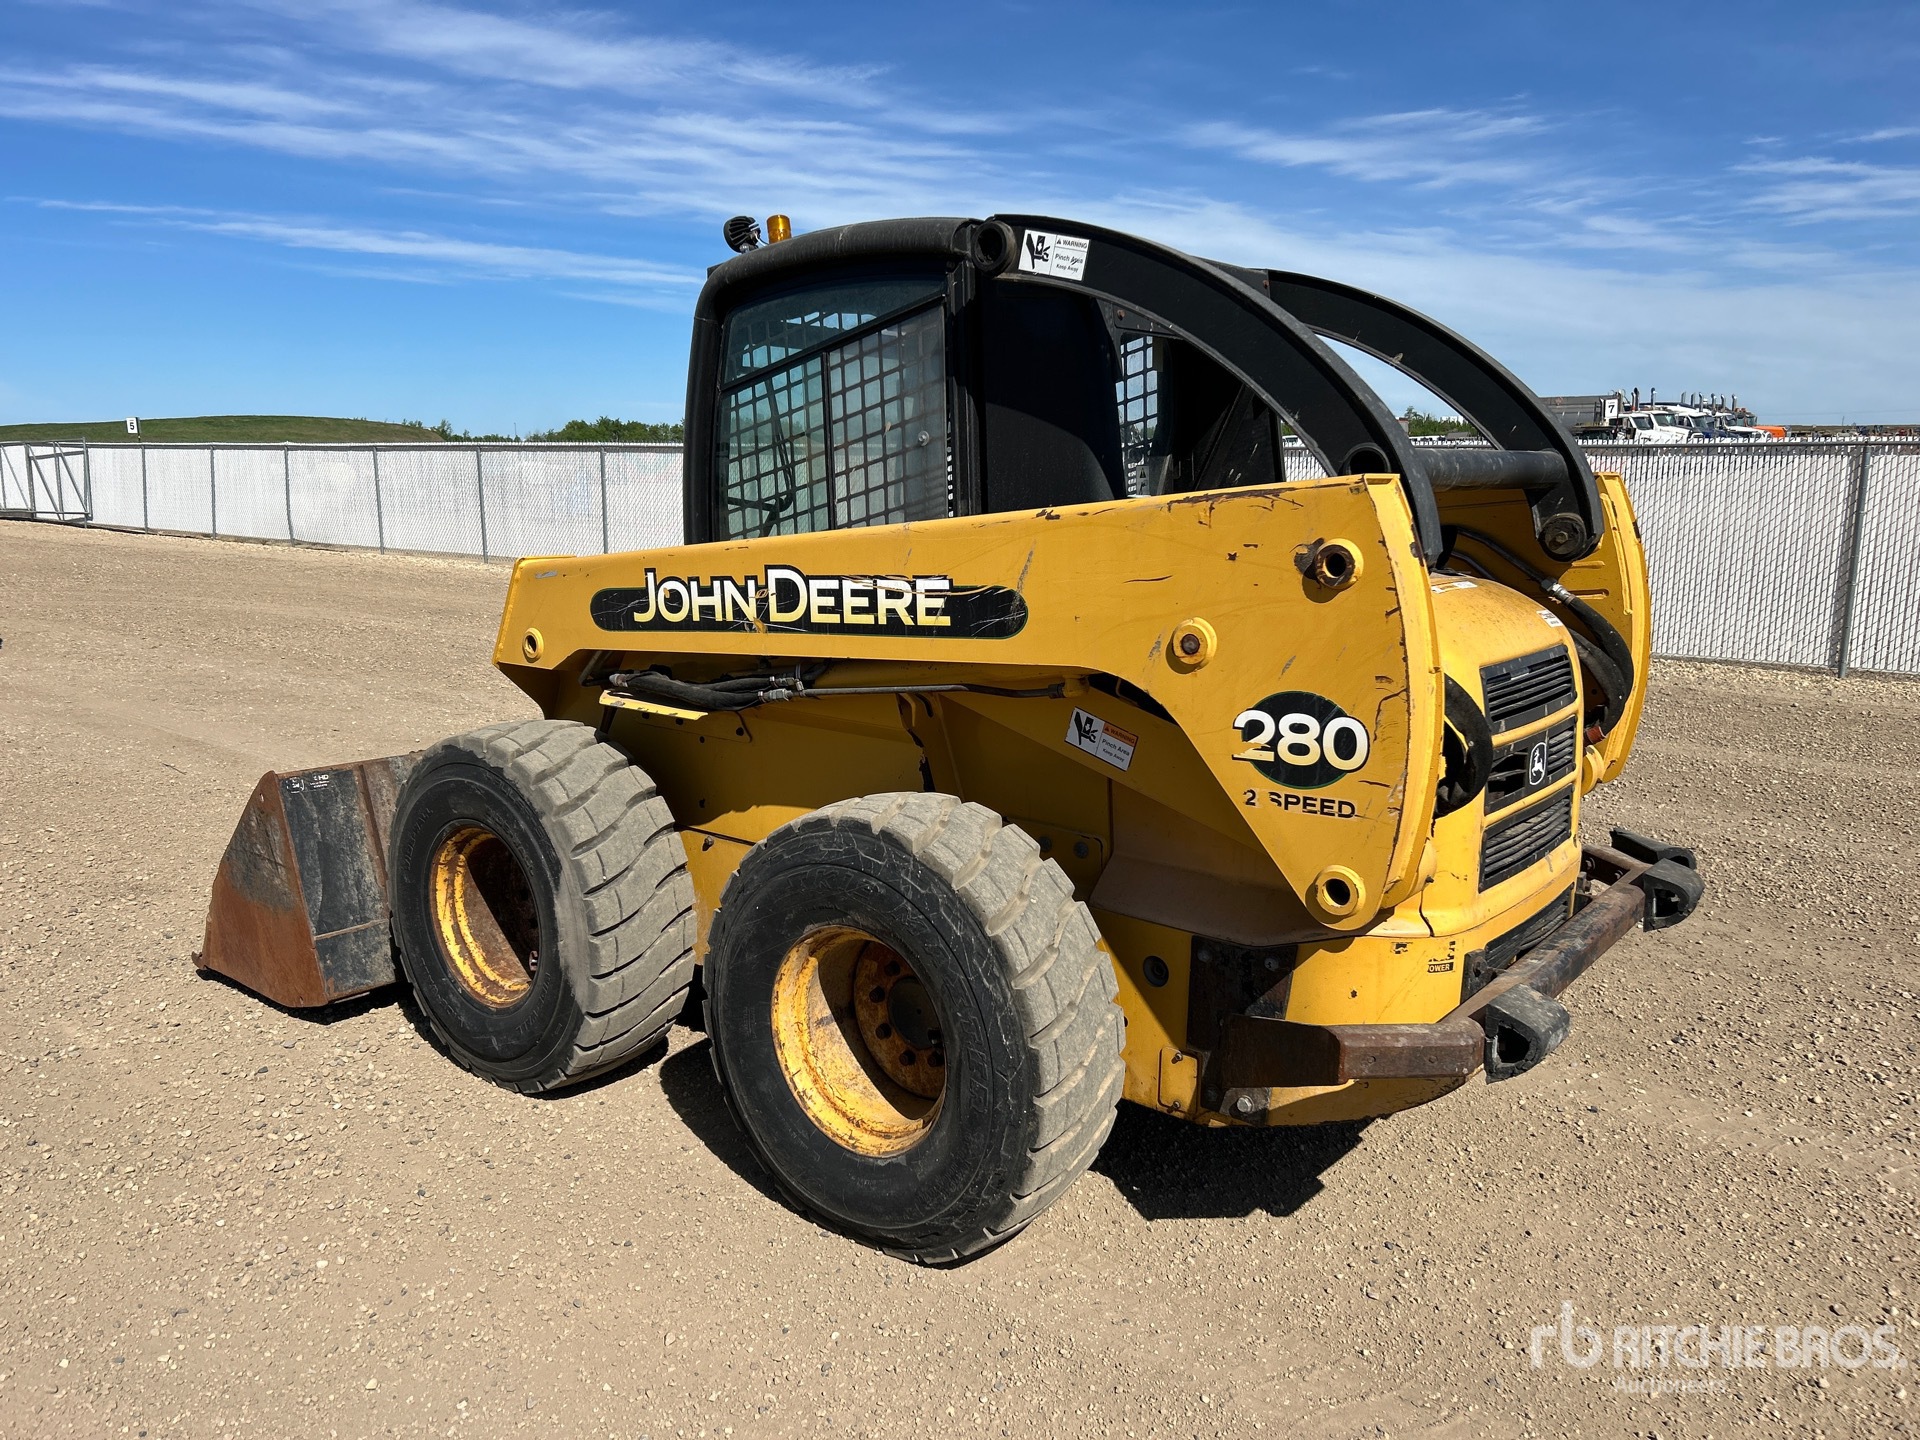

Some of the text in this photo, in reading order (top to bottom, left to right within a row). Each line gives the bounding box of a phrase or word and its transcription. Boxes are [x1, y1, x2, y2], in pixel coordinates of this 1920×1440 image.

[1062, 240, 1087, 248] WARNING
[1054, 253, 1069, 261] Pinch
[1608, 404, 1615, 413] 7
[129, 422, 135, 430] 5
[633, 567, 952, 627] JOHN DEERE
[1110, 728, 1135, 744] WARNING
[1232, 708, 1371, 772] 280
[1102, 738, 1130, 756] Pinch Area
[1103, 748, 1125, 762] Keep Away
[1243, 789, 1356, 819] 2 SPEED
[1428, 963, 1451, 973] OWER
